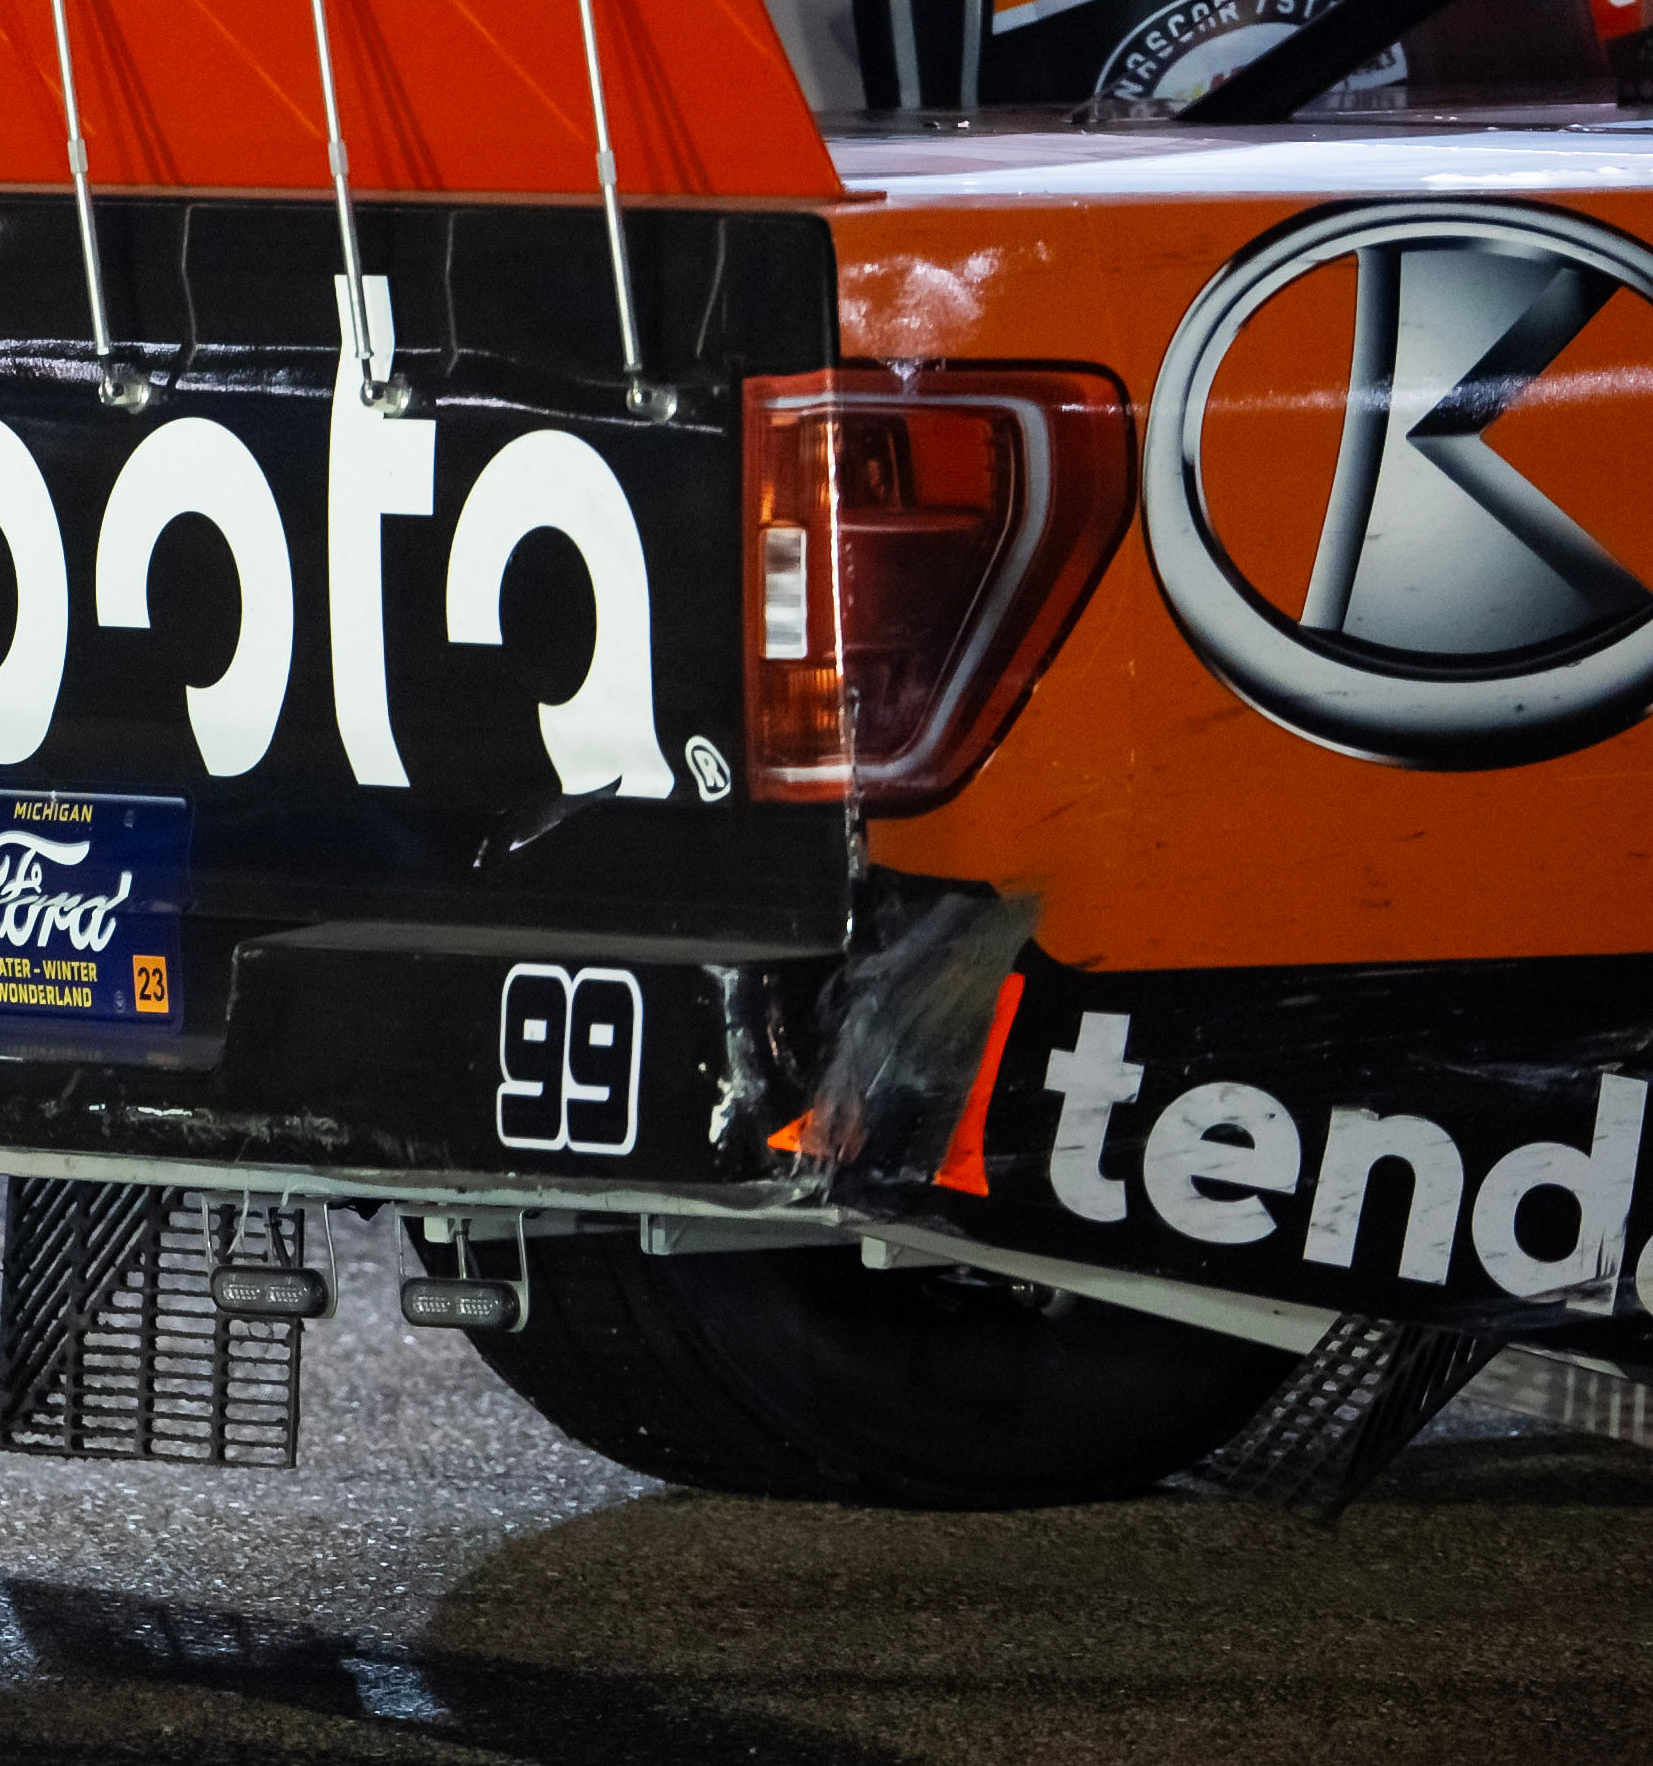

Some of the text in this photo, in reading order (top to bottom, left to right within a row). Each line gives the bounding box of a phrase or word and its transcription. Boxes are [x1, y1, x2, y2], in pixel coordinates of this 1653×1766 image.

[13, 800, 93, 824] MICHIGAN
[43, 960, 98, 983] WINTER
[137, 966, 166, 1002] 23
[496, 962, 644, 1156] 99
[1043, 1011, 1653, 1317] tend
